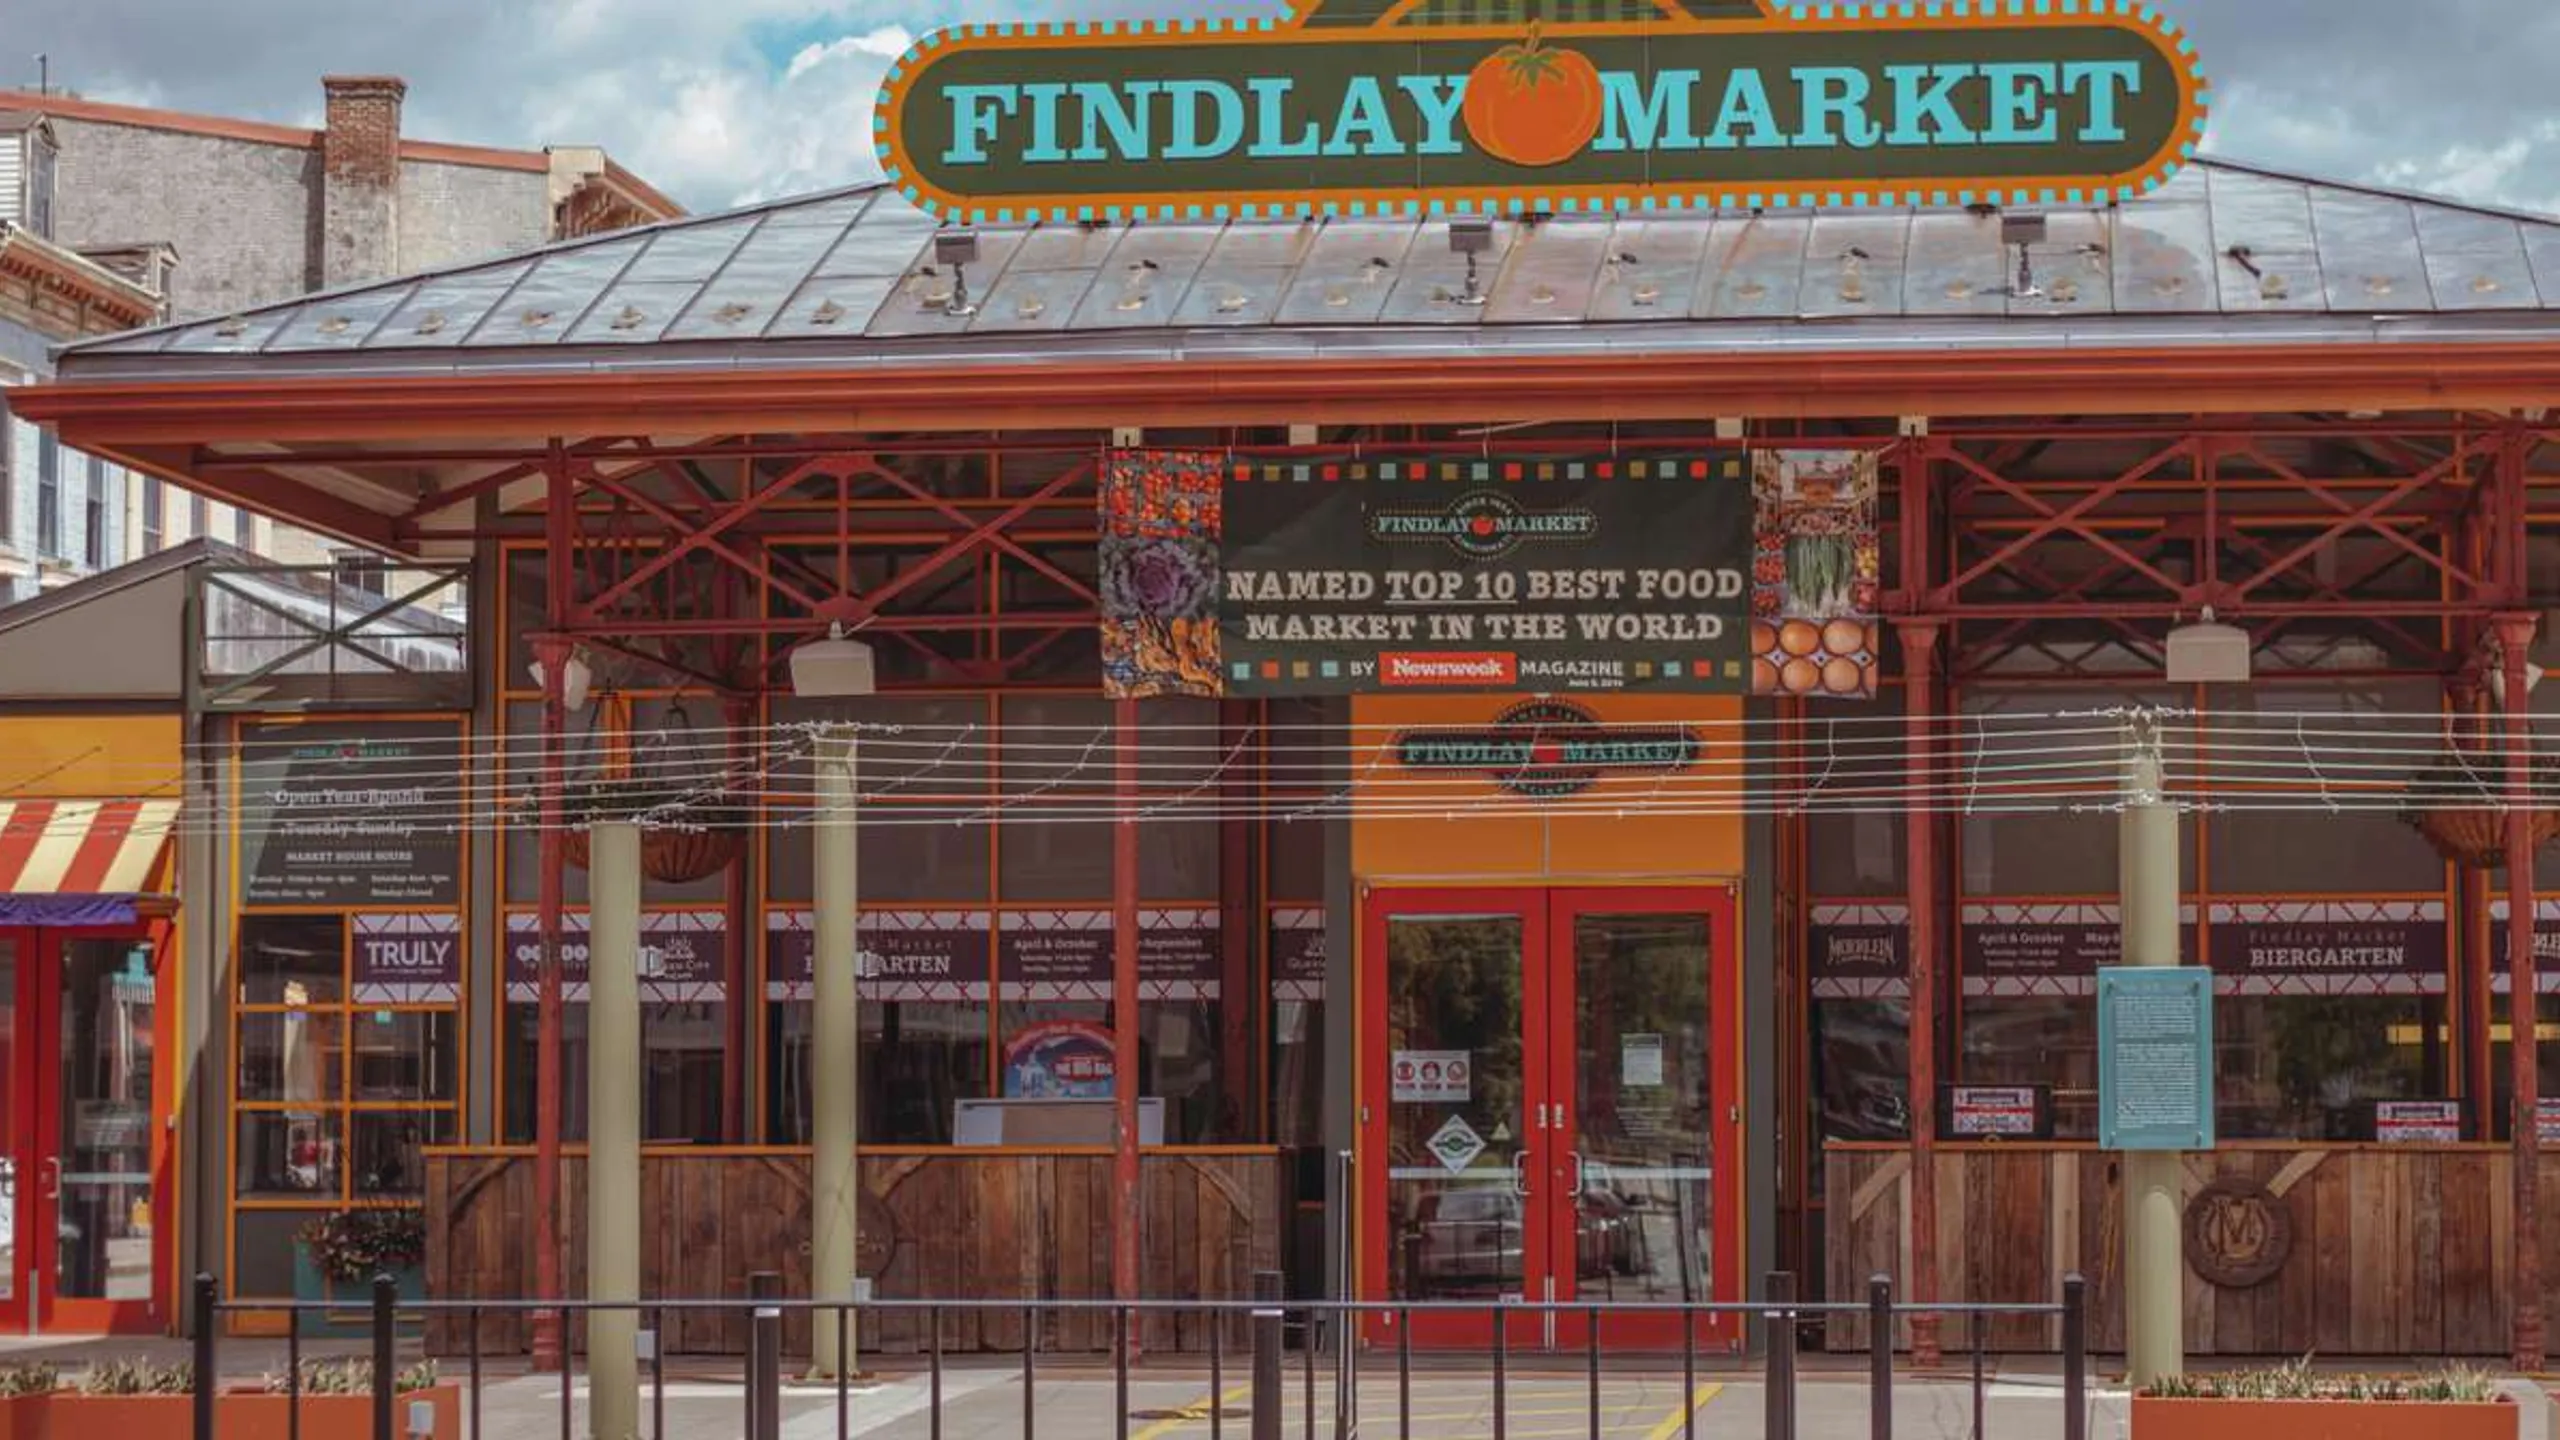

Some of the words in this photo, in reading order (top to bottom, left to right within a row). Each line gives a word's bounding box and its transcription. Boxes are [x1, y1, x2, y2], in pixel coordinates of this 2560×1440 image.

[942, 75, 1471, 164] FINDLAY
[1592, 60, 2141, 152] MARKET
[1378, 516, 1472, 533] FINDLAY
[1494, 515, 1591, 532] MARKET
[1226, 570, 1374, 600] NAMED
[1384, 570, 1463, 599] TOP
[1475, 571, 1516, 599] 10
[1526, 569, 1625, 599] BEST
[1636, 569, 1743, 599] FOOD
[1245, 614, 1417, 640] MARKET
[1428, 614, 1474, 640] IN
[1484, 613, 1567, 640] THE
[1576, 613, 1723, 640] WORLD
[1350, 660, 1375, 677] BY
[1391, 657, 1504, 678] Newsweek
[1520, 660, 1624, 677] MAGAZINE
[1405, 742, 1534, 763] FINDLAY
[1563, 741, 1690, 762] MARKET
[275, 790, 320, 806] Open
[365, 940, 451, 967] TRULY
[2250, 947, 2405, 967] BIERGARTEN
